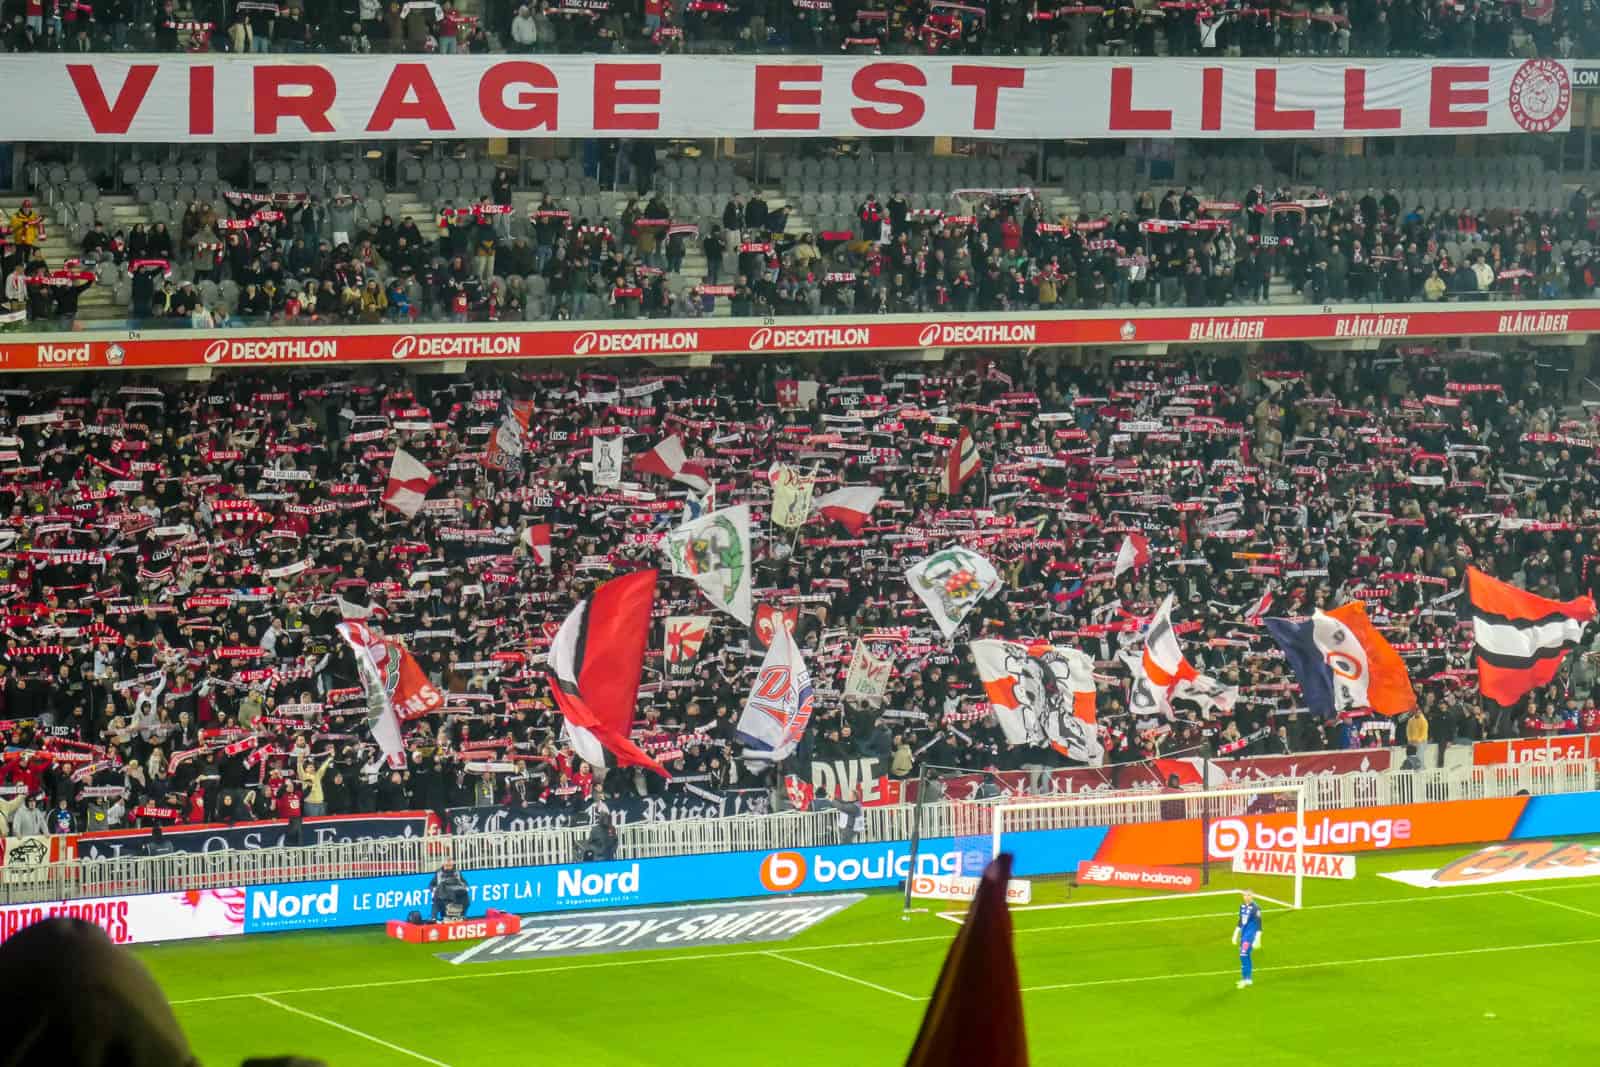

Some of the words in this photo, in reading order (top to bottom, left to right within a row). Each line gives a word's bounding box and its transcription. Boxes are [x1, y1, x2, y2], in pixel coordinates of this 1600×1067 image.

[66, 60, 662, 135] VIRAGE
[753, 62, 1025, 130] EST
[1109, 66, 1490, 130] LILLE
[1260, 236, 1279, 245] LOSC
[1190, 321, 1264, 339] BLÅKLÄDER
[1336, 317, 1408, 336] BLÅKLÄDER
[1498, 312, 1569, 333] BLÅKLÄDER
[600, 332, 698, 351] DECATHLON
[774, 328, 869, 348] DECATHLON
[943, 325, 1036, 343] DECATHLON
[37, 343, 90, 363] Nord
[231, 340, 337, 360] DECATHLON
[419, 336, 521, 355] DECATHLON
[550, 432, 567, 440] LOSC
[533, 496, 553, 507] LOSC
[51, 726, 69, 736] LOSC
[811, 757, 881, 802] DVE
[1256, 817, 1412, 850] boulange
[1244, 851, 1344, 876] WINAMAX
[557, 863, 640, 898] Nord
[1115, 871, 1139, 881] new
[1141, 872, 1193, 885] balance
[353, 893, 371, 911] LE
[482, 883, 509, 900] EST
[514, 880, 532, 899] LÀ
[536, 881, 541, 897] !
[939, 880, 1025, 898] bouler
[253, 884, 338, 919] Nord
[50, 899, 133, 944] CES.
[447, 922, 487, 940] LOSC
[490, 917, 685, 954] TEDDY
[656, 905, 844, 943] SMITH
